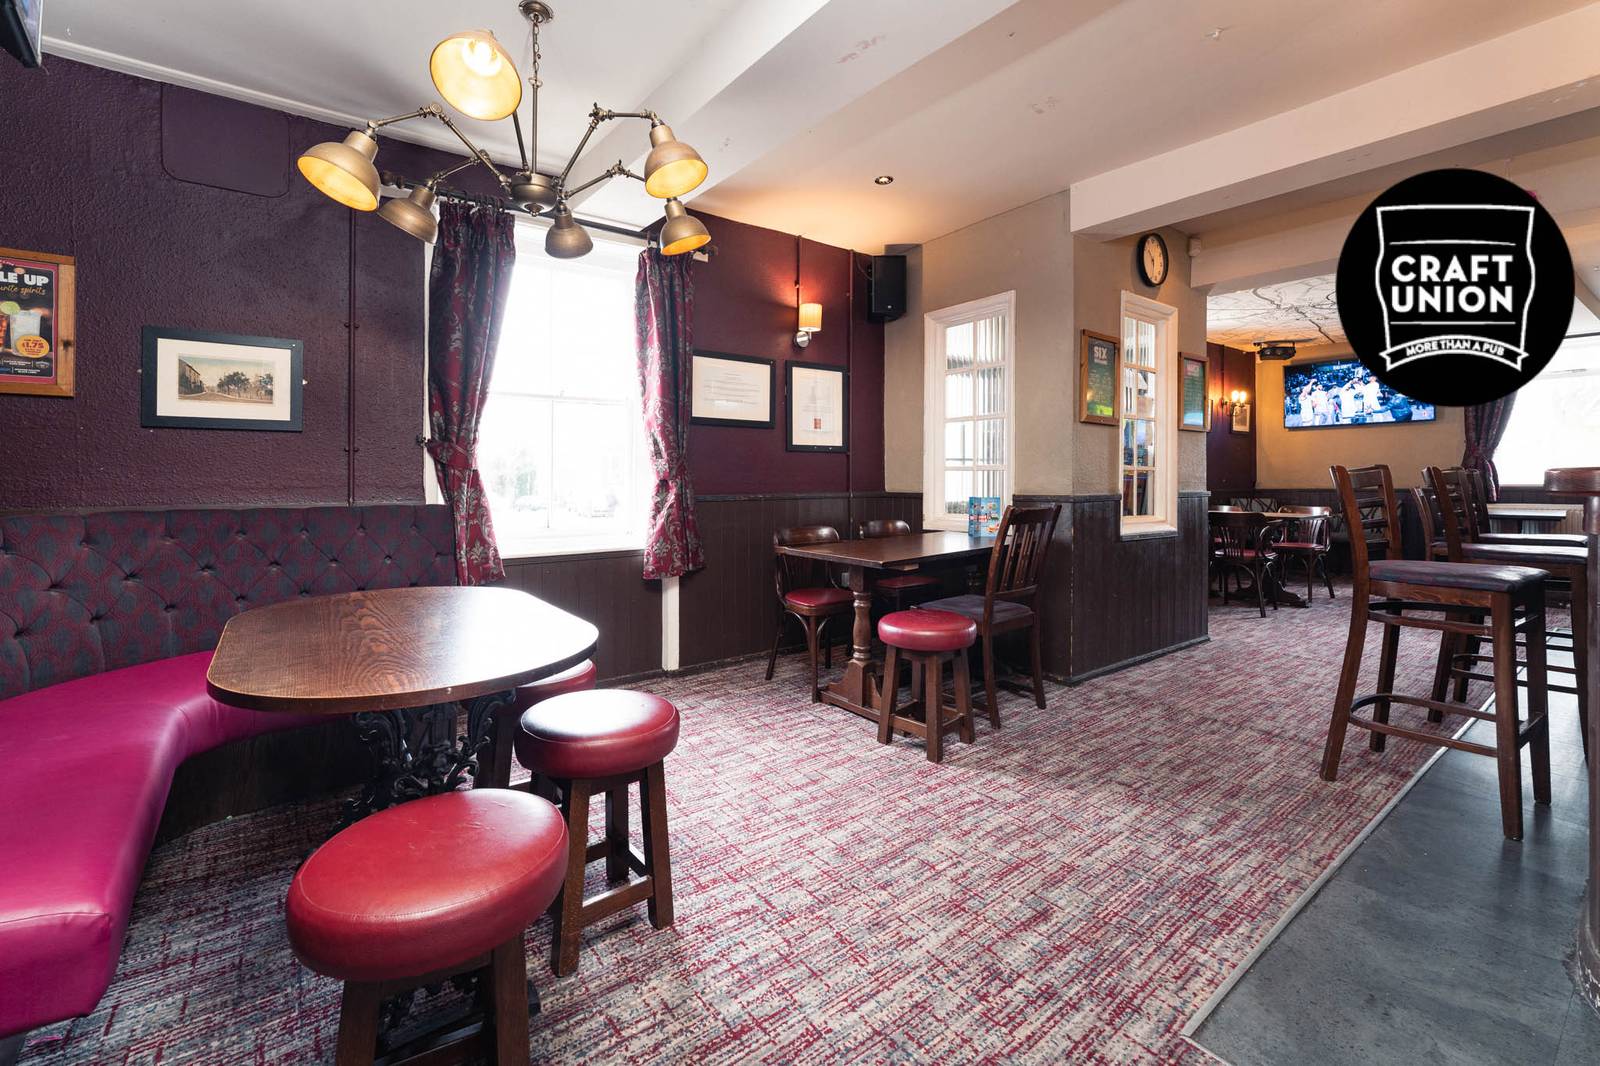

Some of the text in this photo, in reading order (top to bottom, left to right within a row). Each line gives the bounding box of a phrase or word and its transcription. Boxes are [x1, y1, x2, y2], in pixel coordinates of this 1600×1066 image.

[24, 274, 49, 287] UP
[20, 287, 46, 296] spirits
[1093, 345, 1108, 360] SIX
